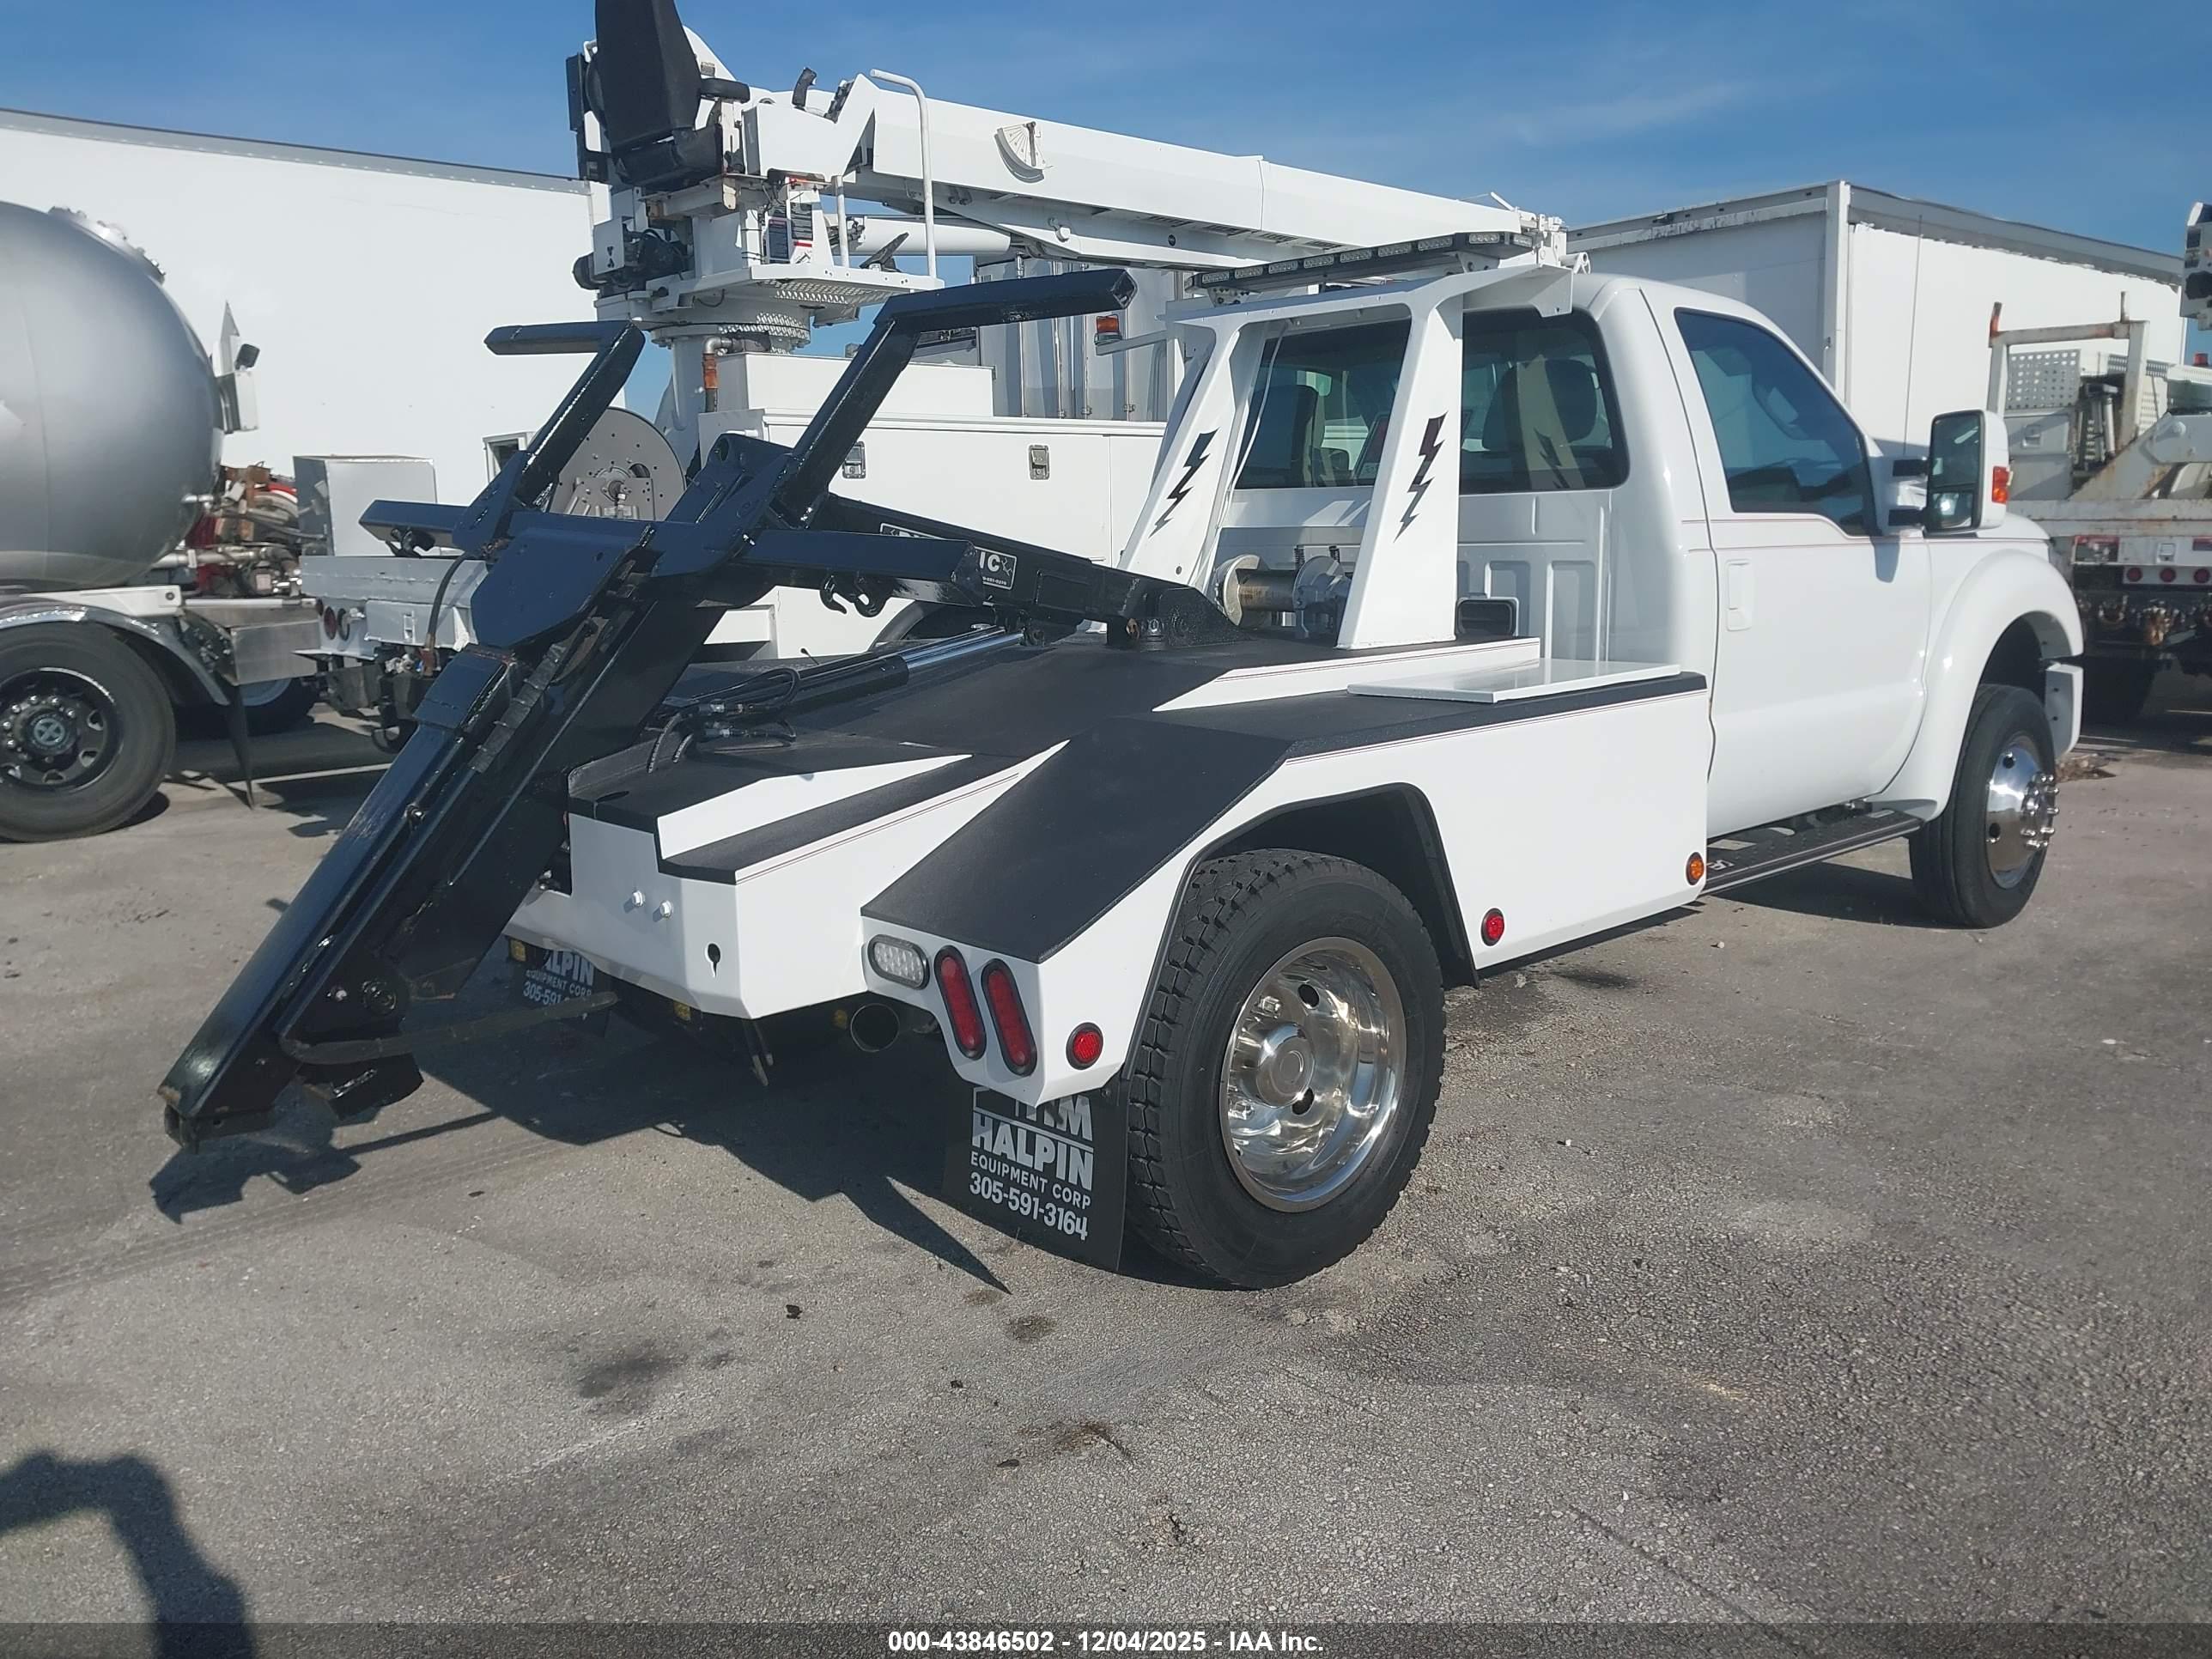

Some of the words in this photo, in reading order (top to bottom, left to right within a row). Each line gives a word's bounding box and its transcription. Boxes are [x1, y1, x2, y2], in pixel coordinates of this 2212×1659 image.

[569, 982, 592, 997] CORP
[970, 1152, 1048, 1194] EQUIPMENT
[1052, 1183, 1091, 1211] CORP
[971, 1111, 1094, 1191] HALPIN
[969, 1171, 1089, 1242] 305-591-3164
